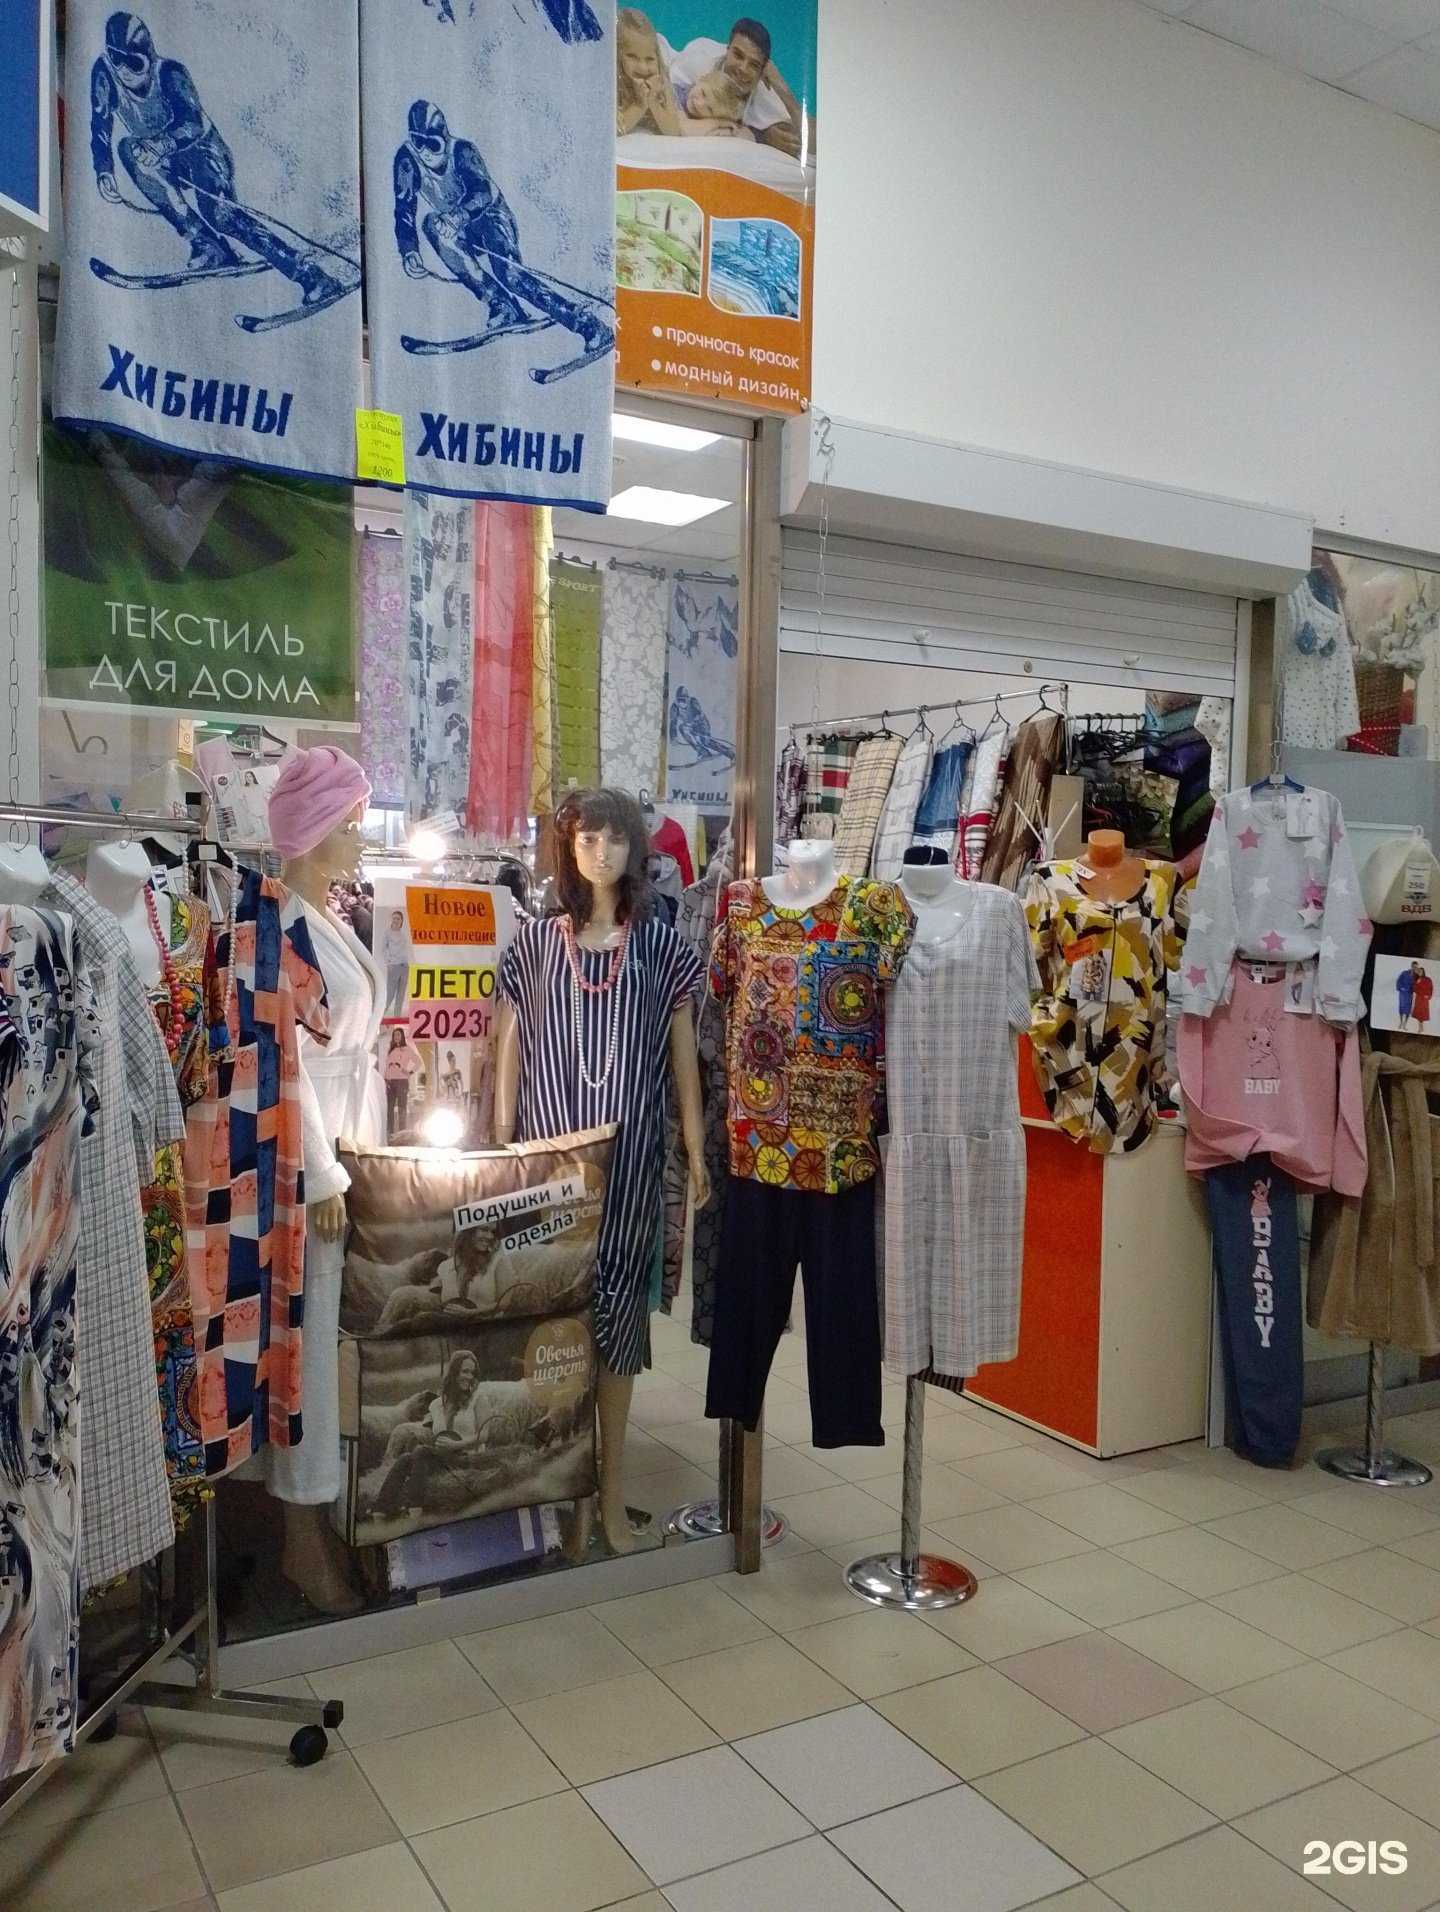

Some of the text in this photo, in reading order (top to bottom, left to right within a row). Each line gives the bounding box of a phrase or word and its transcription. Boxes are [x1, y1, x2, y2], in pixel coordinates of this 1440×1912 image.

[666, 327, 800, 370] прочность красок
[665, 361, 800, 401] модный дизайн
[104, 600, 304, 656] ТЕКСТИЛЬ
[89, 655, 320, 706] ДЛЯ ДОМА
[423, 893, 487, 917] Новое
[411, 969, 496, 998] ЛЕТО
[1244, 1079, 1280, 1094] BABY
[457, 1188, 550, 1226] Подушки
[561, 1183, 573, 1197] и
[504, 1213, 574, 1250] одеяла
[536, 1344, 585, 1364] Овечья
[533, 1360, 588, 1386] шерсть
